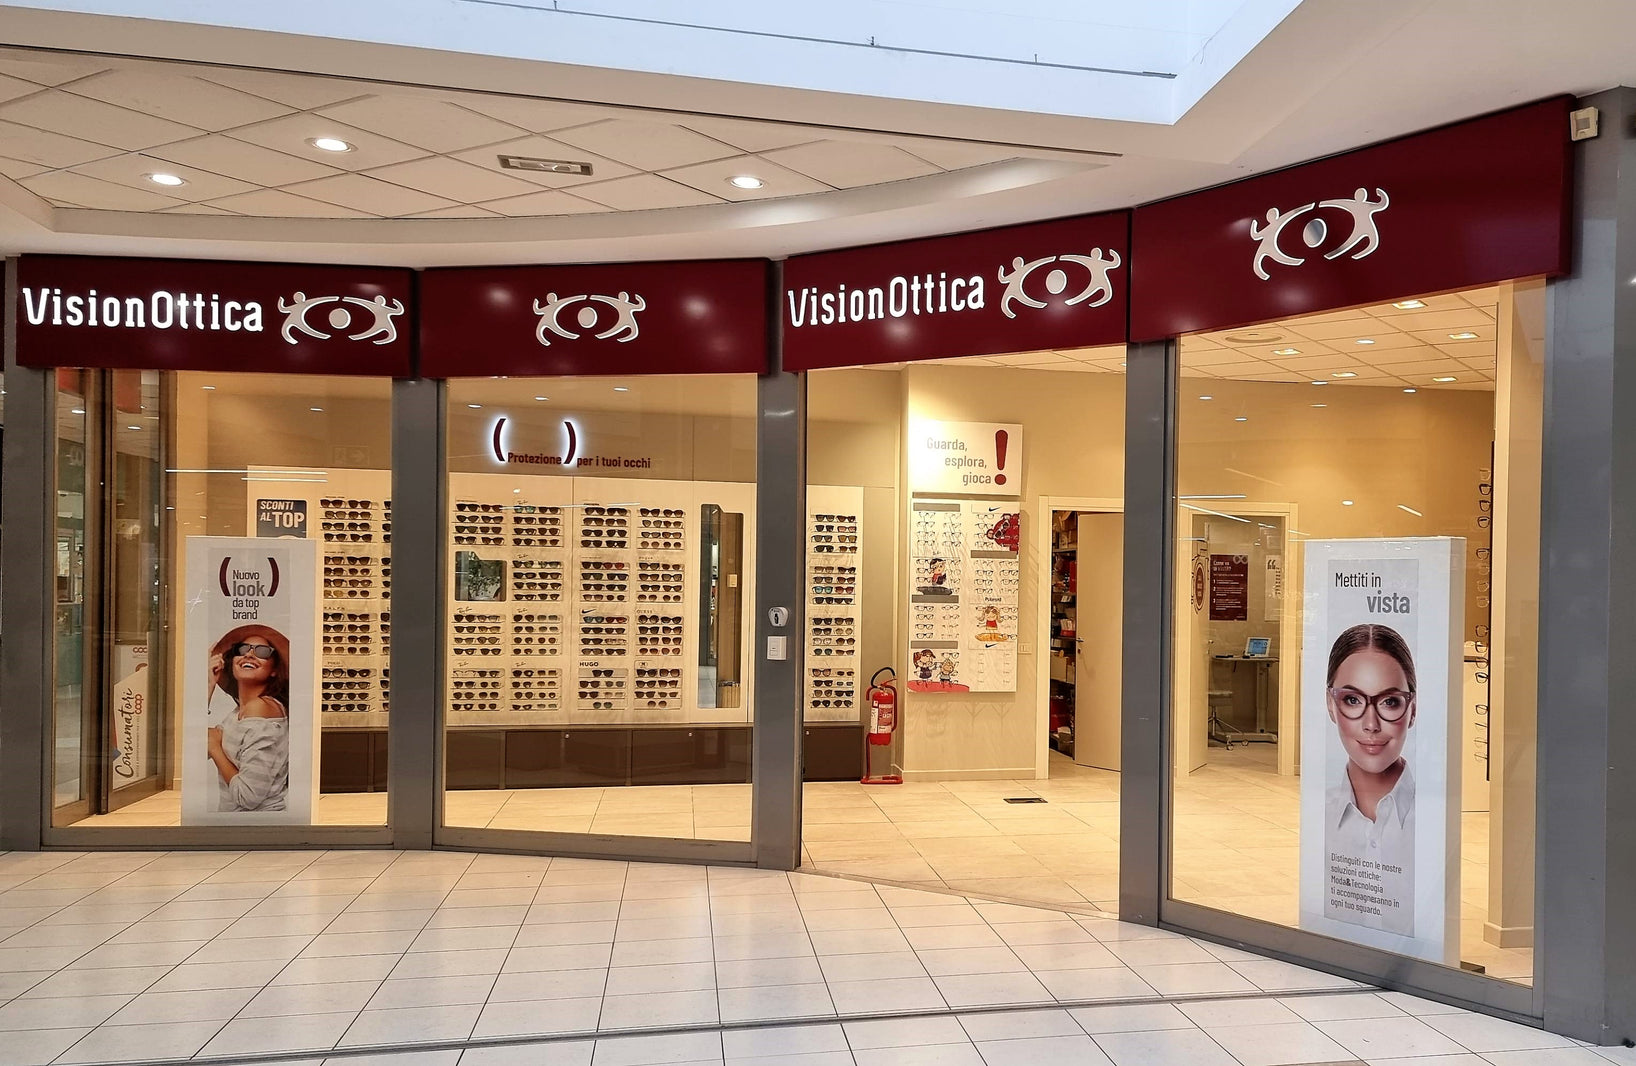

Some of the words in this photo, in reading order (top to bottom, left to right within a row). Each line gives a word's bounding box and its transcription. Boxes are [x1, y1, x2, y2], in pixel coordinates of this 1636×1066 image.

[787, 273, 985, 327] VisionOttica
[22, 288, 263, 332] VisionOttica
[927, 437, 967, 452] Guarda,
[577, 457, 593, 468] per
[602, 456, 621, 468] tuoi
[624, 457, 651, 469] occhi
[945, 455, 987, 469] esplora,
[260, 500, 294, 510] SCONTI
[260, 512, 272, 522] AL
[272, 511, 305, 528] TOP
[232, 569, 260, 580] Nuovo
[1335, 572, 1368, 588] Mettiti
[1371, 572, 1382, 588] in
[232, 581, 266, 597] look
[232, 598, 244, 608] da
[245, 598, 260, 610] top
[1366, 590, 1410, 613] vista
[232, 609, 258, 620] brand
[115, 687, 135, 779] Consumatori
[1331, 853, 1361, 866] Distinguiti
[1362, 860, 1374, 868] con
[1375, 861, 1381, 870] le
[1382, 864, 1402, 873] nostre
[1331, 866, 1357, 876] soluzioni
[1358, 870, 1382, 881] ottiche:
[1337, 889, 1393, 906] accompagneranno
[1394, 899, 1400, 908] in
[1331, 899, 1344, 908] ogni
[1345, 901, 1355, 910] tuo
[1356, 904, 1382, 916] sguardo.
